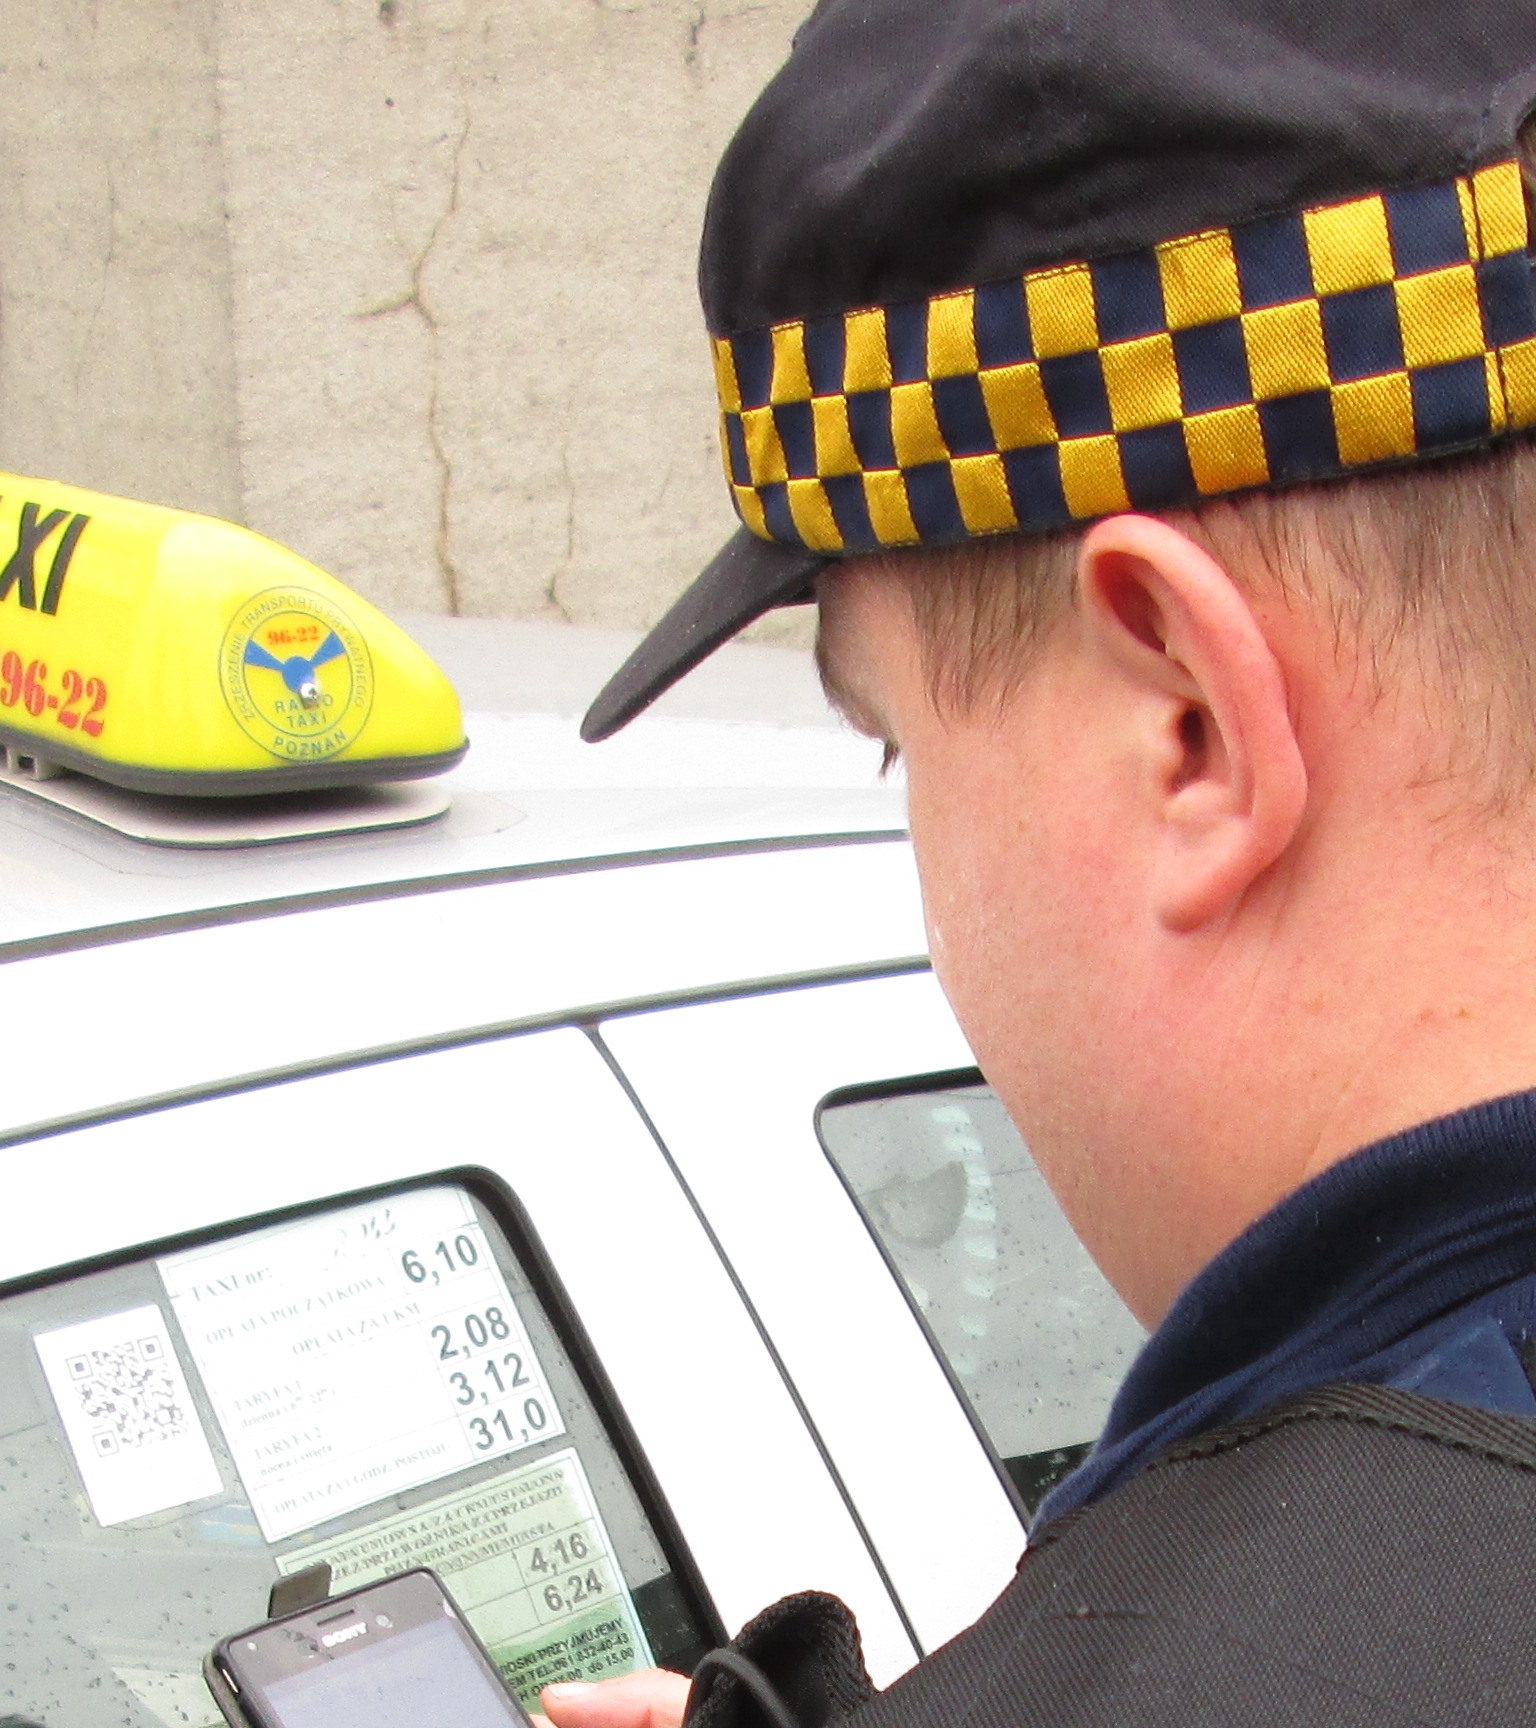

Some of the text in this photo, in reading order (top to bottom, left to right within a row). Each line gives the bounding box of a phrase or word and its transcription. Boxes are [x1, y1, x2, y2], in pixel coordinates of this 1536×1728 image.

[286, 713, 328, 729] TAXI
[401, 1234, 479, 1286] 6,10
[191, 1275, 239, 1301] TAXI
[431, 1306, 512, 1360] 2,08
[449, 1352, 531, 1406] 3,12
[468, 1398, 548, 1451] 31,0
[531, 1533, 588, 1576] 4,16
[544, 1568, 603, 1612] 6,24
[321, 1622, 367, 1648] SONY
[536, 1618, 624, 1658] PRZYJMUJEMY
